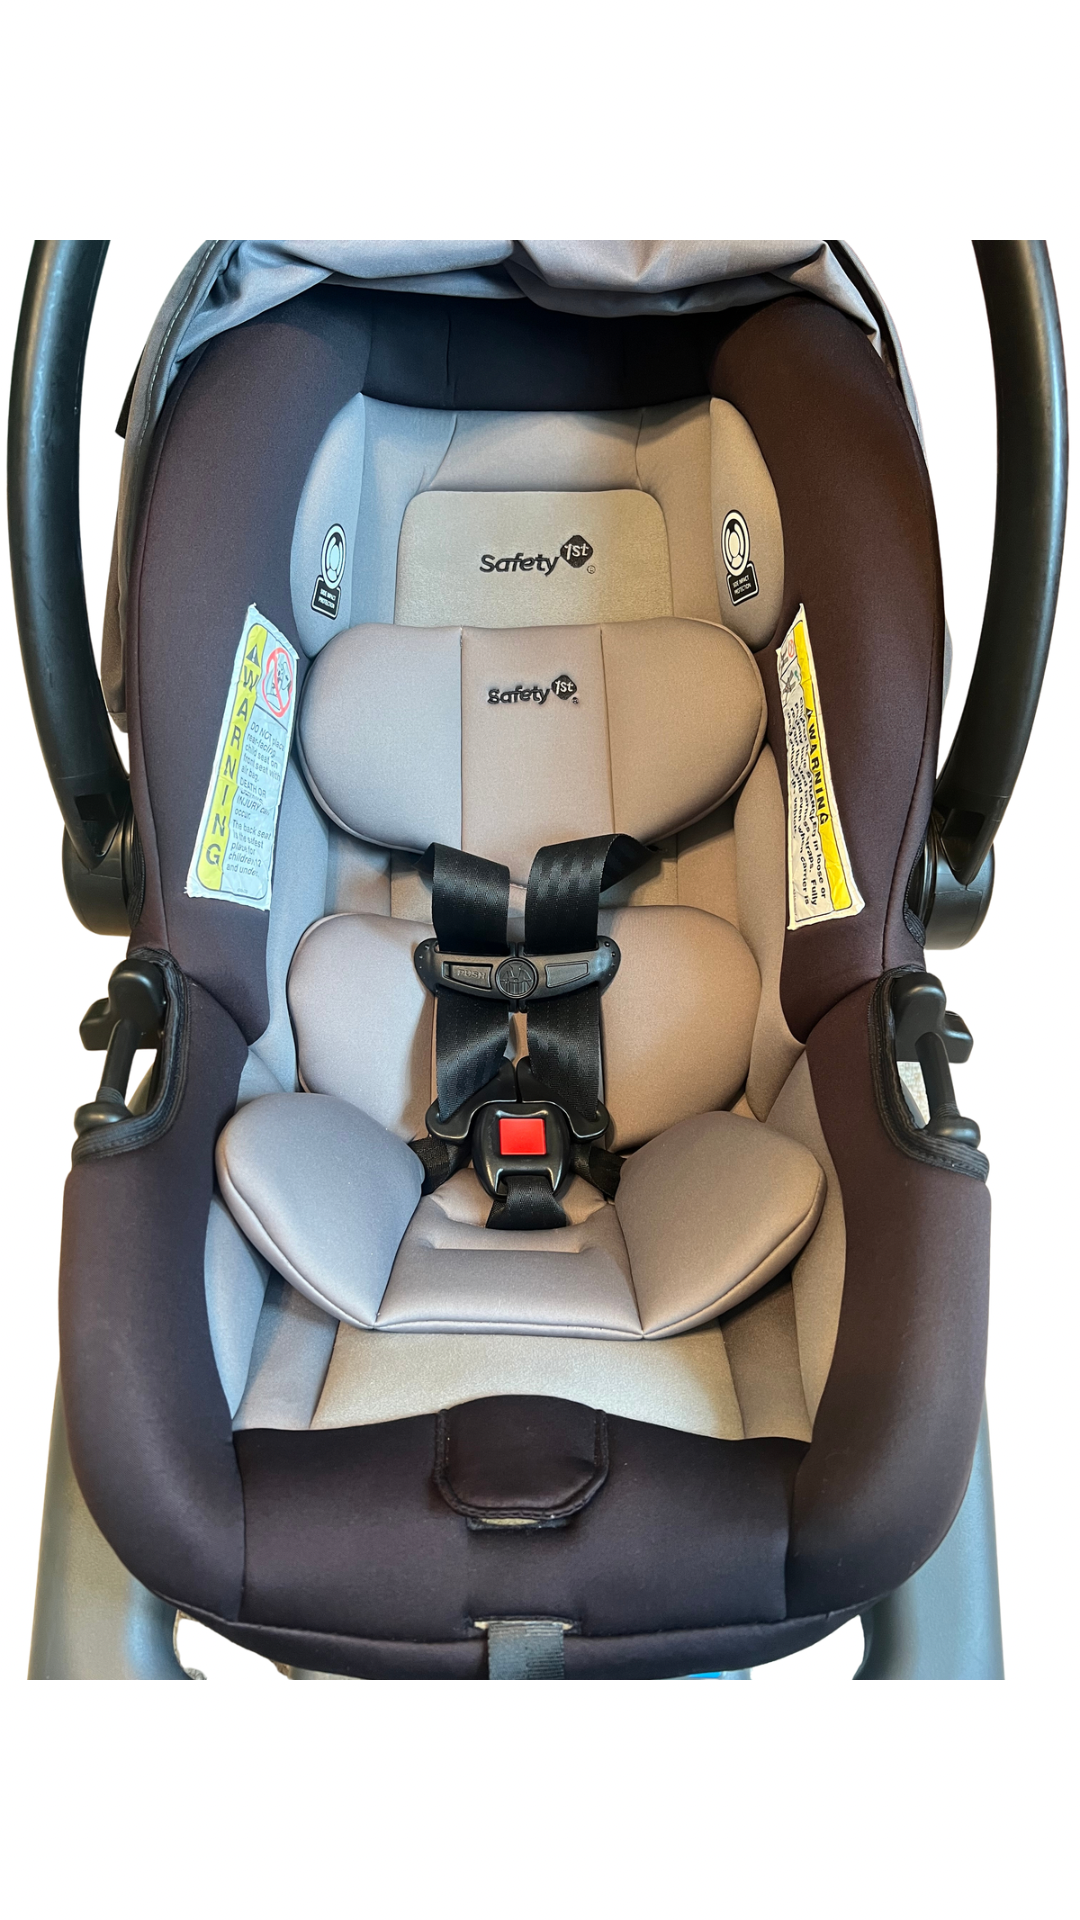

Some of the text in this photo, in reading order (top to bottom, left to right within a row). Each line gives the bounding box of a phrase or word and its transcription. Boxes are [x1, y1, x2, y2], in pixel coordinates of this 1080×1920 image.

[480, 543, 589, 577] Safety 1st
[488, 680, 574, 705] Safety 1st
[250, 721, 259, 733] DO
[259, 727, 272, 742] NOT
[245, 744, 278, 769] child seat on
[247, 733, 276, 758] rear-facing
[206, 665, 260, 866] WARNING
[255, 763, 268, 775] seat
[808, 723, 829, 826] WARNING
[240, 776, 257, 794] DEATH
[257, 787, 267, 799] OR
[237, 795, 261, 811] INJURY
[257, 829, 272, 840] seat
[226, 863, 239, 873] and
[816, 854, 825, 883] loose
[820, 887, 827, 898] or
[457, 968, 486, 980] PUSH
